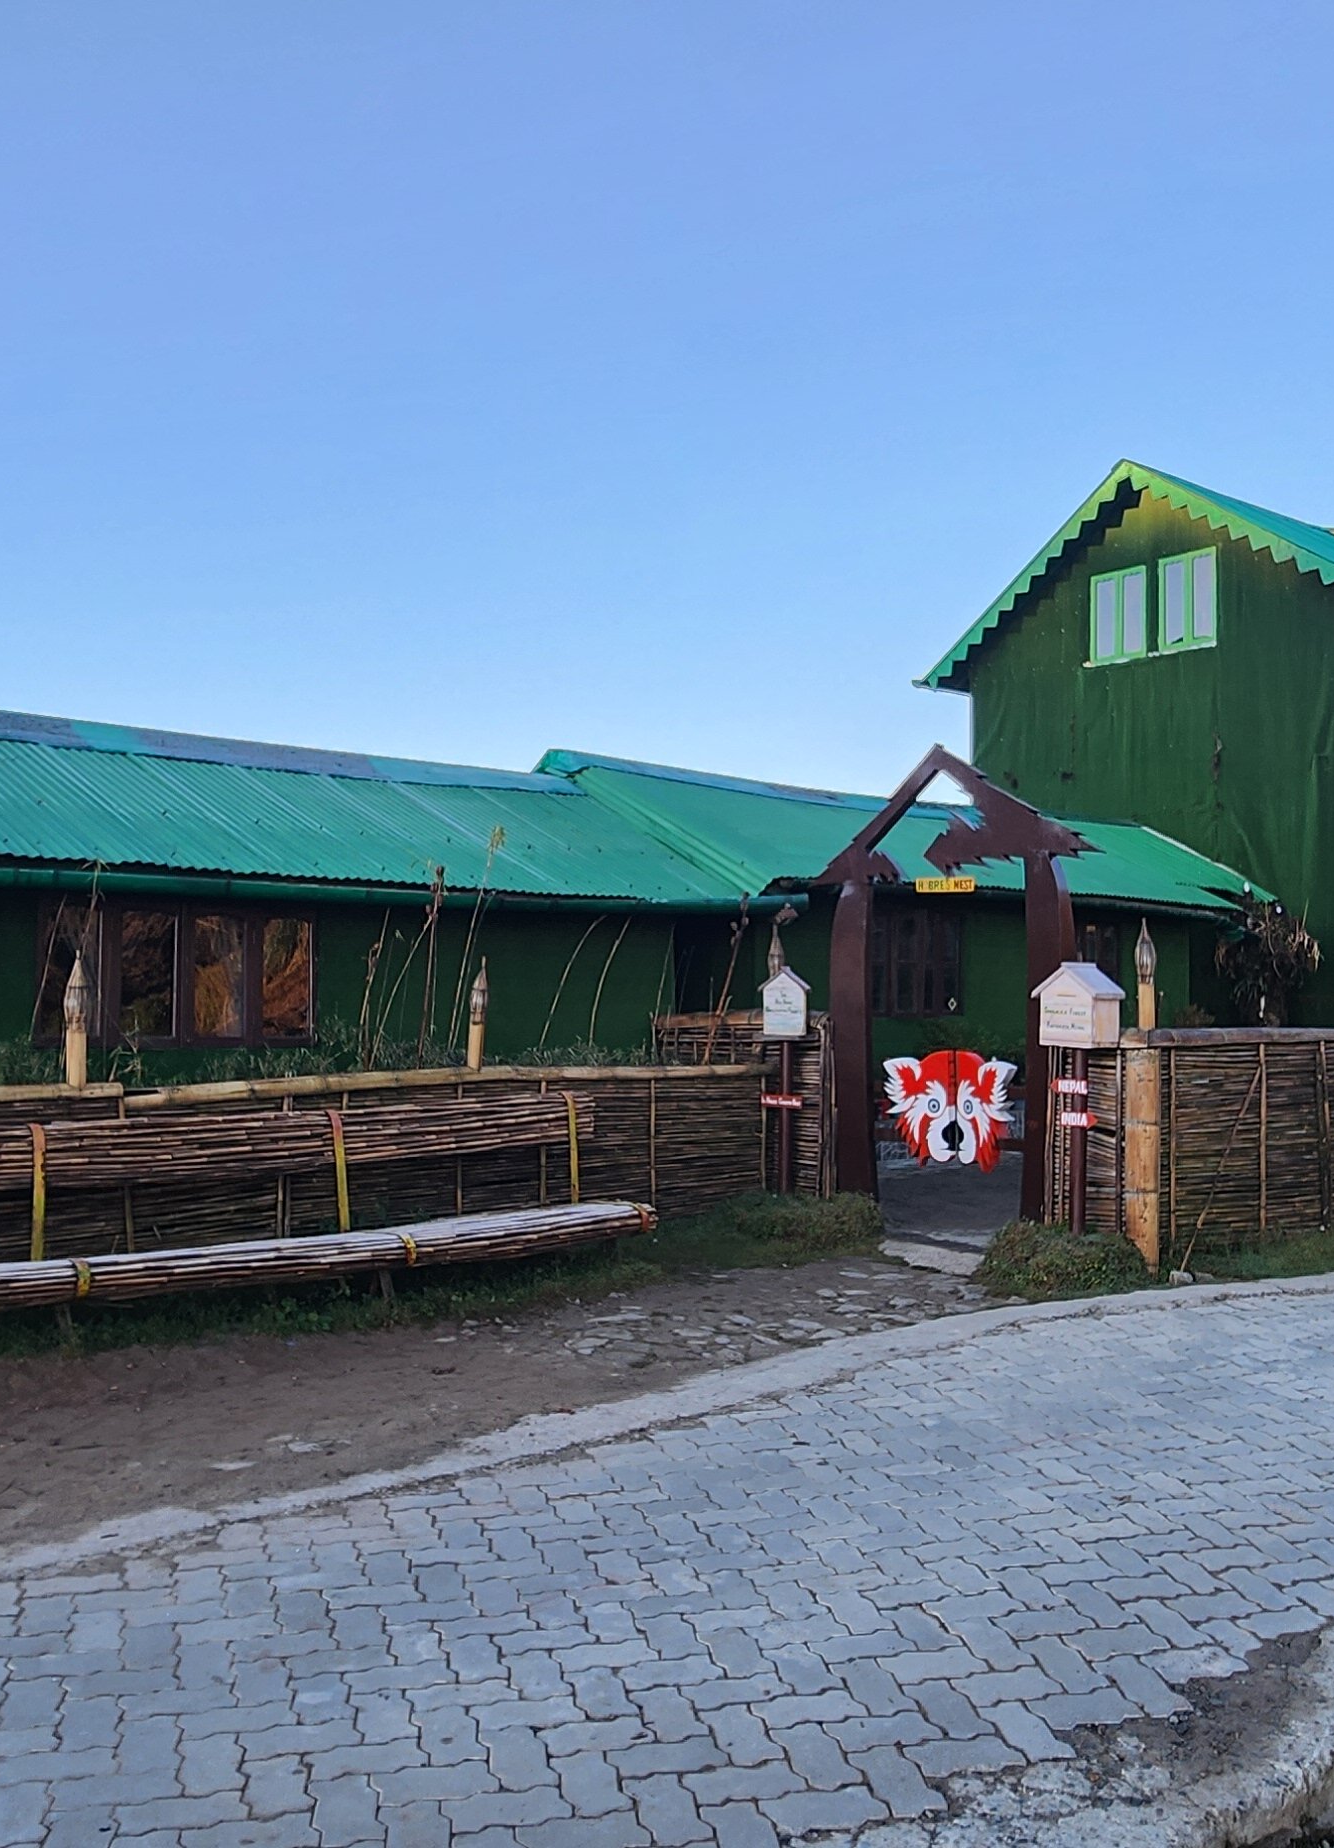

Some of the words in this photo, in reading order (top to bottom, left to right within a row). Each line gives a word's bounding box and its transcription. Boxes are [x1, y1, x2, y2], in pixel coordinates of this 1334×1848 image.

[953, 879, 973, 890] NEST
[1058, 1079, 1088, 1095] NEPAL
[1061, 1112, 1088, 1127] INDIA
